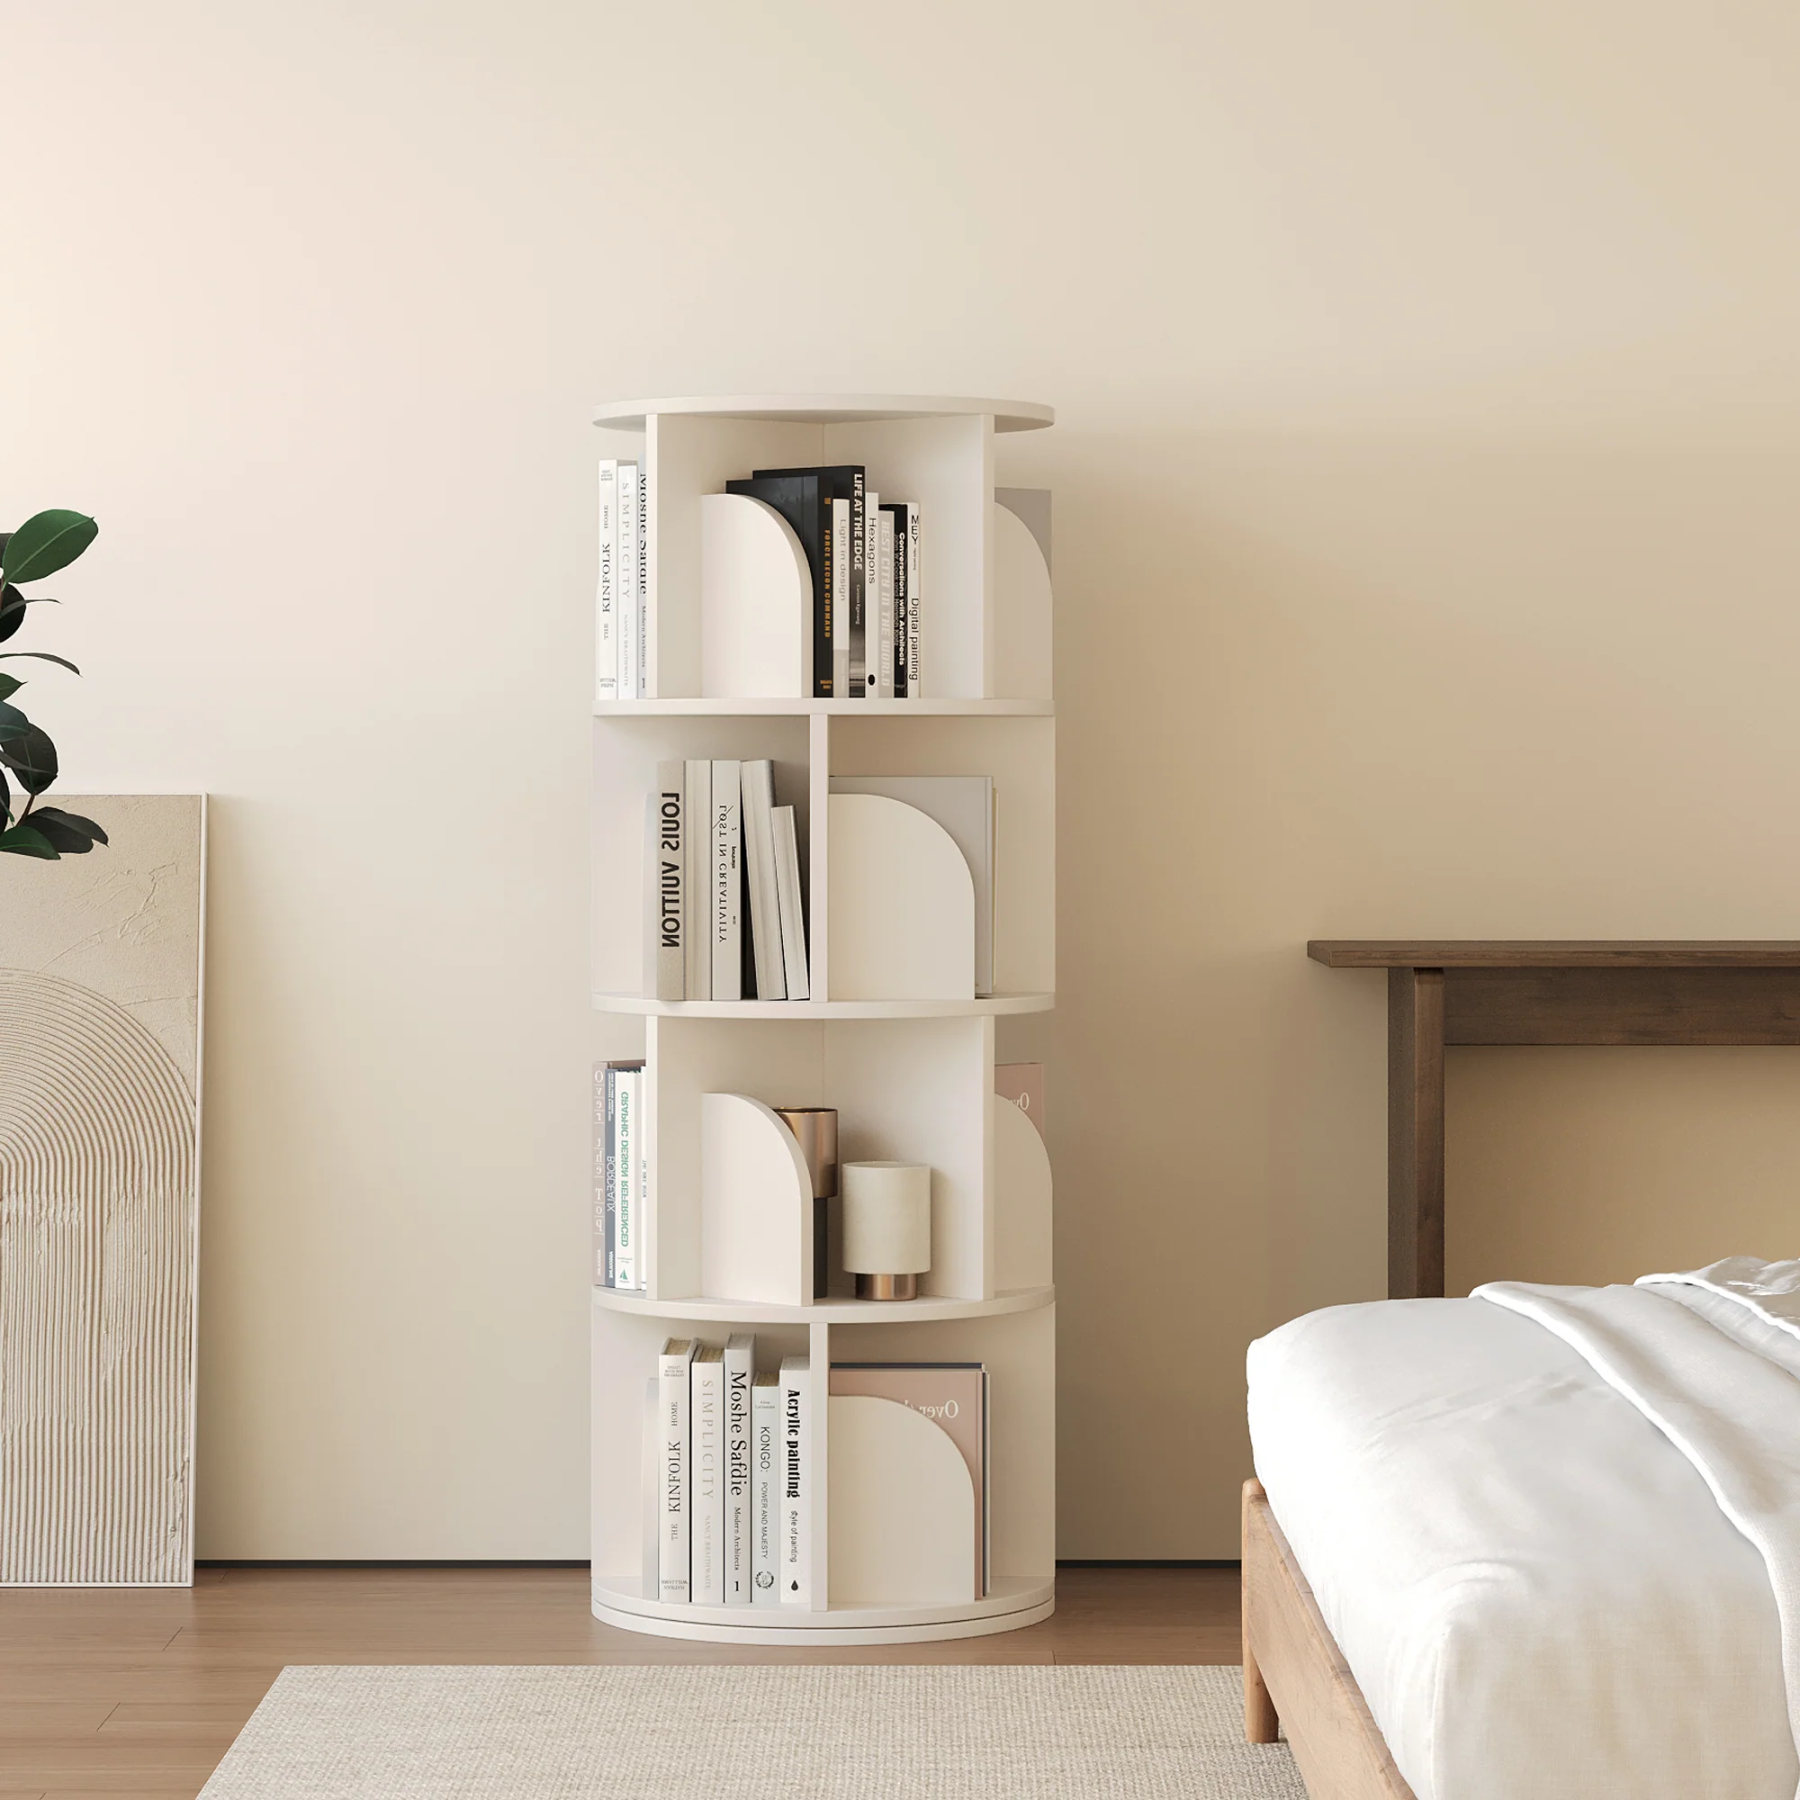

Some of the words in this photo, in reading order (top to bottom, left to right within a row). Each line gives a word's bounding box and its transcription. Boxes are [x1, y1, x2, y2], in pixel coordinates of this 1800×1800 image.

[854, 474, 862, 497] LIFE
[854, 499, 862, 515] AT
[854, 516, 862, 538] THE
[622, 482, 630, 598] SIMPLICITY
[840, 550, 846, 560] in
[854, 540, 862, 570] EDGE
[867, 517, 877, 584] Hexagons
[881, 522, 890, 554] BEST
[602, 543, 611, 613] KINFOLK
[881, 557, 891, 586] CITY
[881, 610, 891, 635] THE
[909, 597, 919, 633] Digital
[881, 640, 891, 687] WORLD
[909, 636, 919, 681] painting
[730, 1371, 747, 1433] Moshe
[786, 1389, 801, 1436] Acrylic
[702, 1380, 714, 1500] SIMPLICITY
[760, 1427, 770, 1472] KONGO:
[668, 1441, 681, 1514] KINFOLK
[730, 1440, 747, 1496] Safdie
[786, 1440, 801, 1499] painting
[790, 1510, 798, 1526] style
[790, 1527, 798, 1535] of
[790, 1536, 798, 1563] painting
